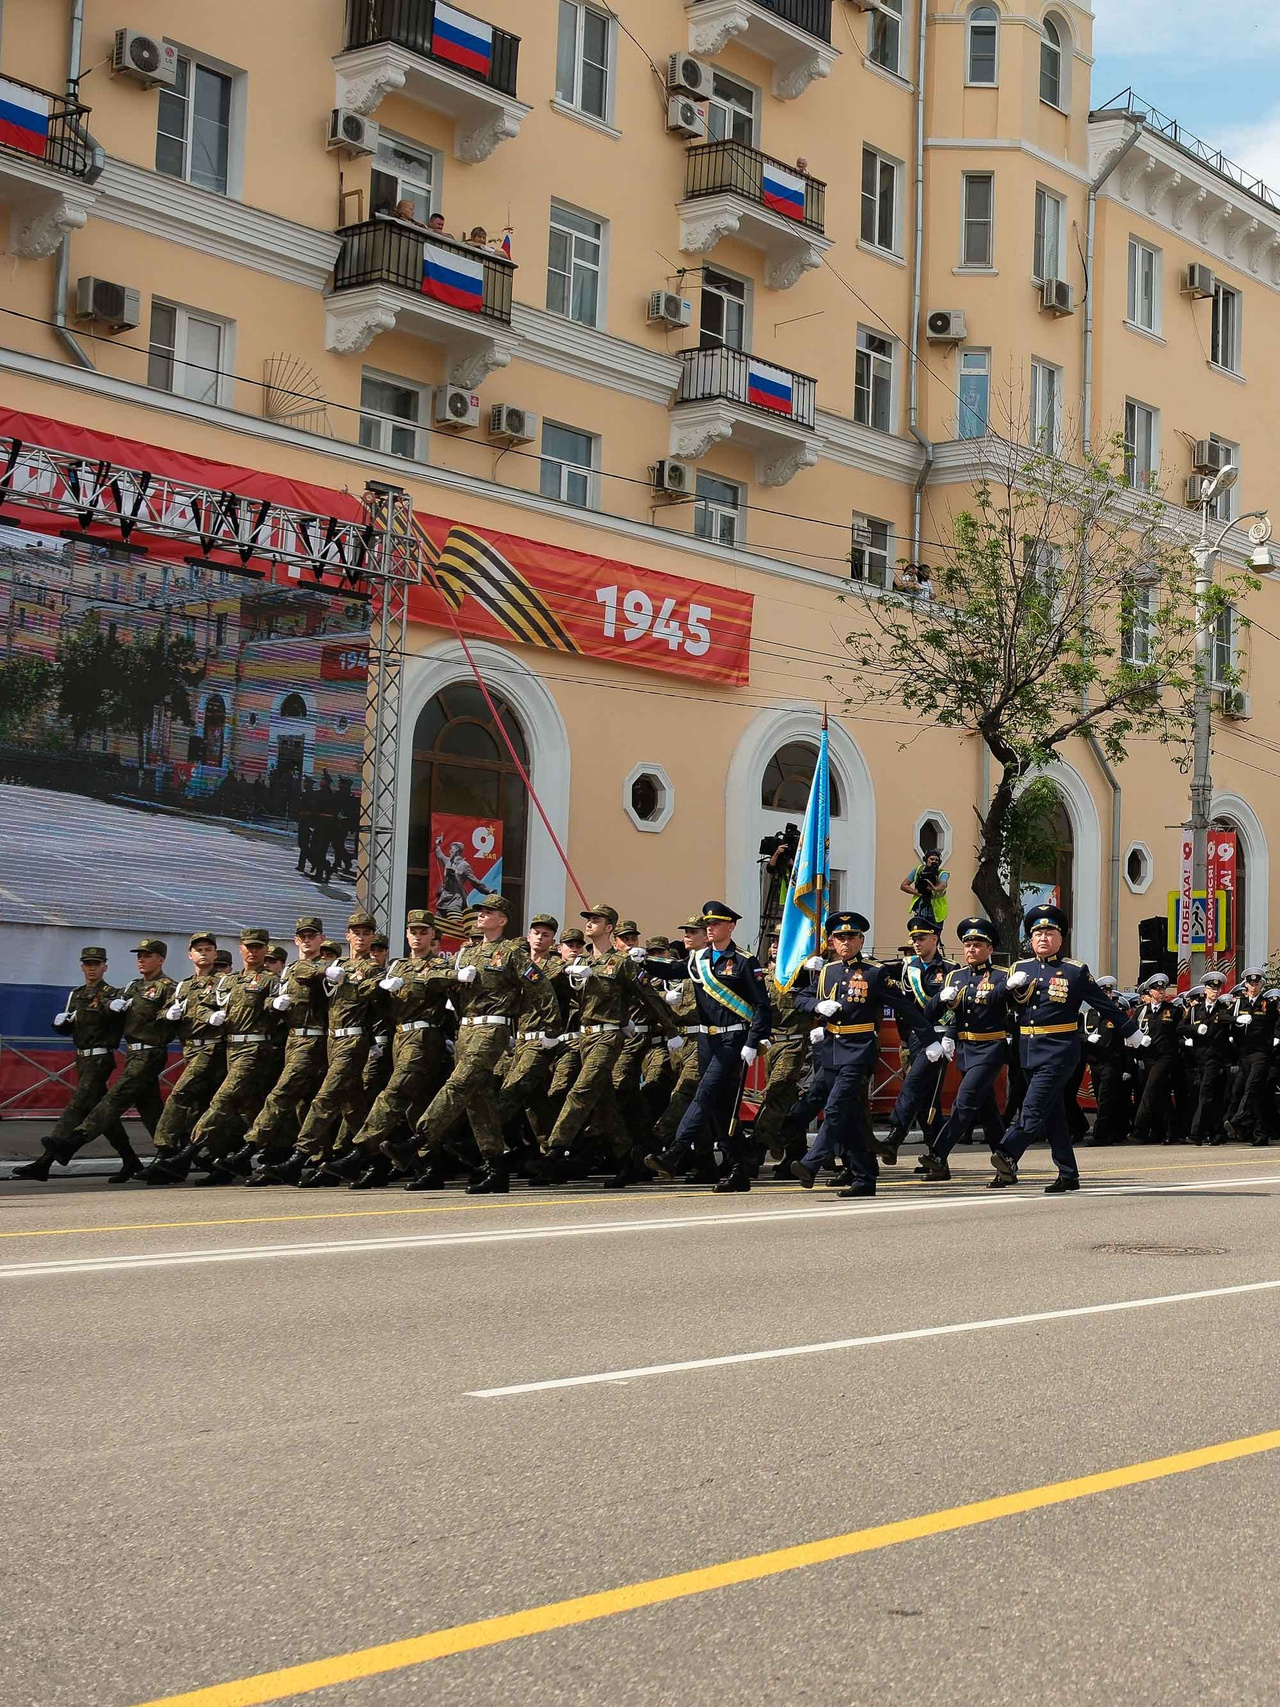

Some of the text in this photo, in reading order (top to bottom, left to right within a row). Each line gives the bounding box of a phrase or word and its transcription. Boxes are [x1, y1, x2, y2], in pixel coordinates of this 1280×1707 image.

[595, 584, 712, 656] 1945
[472, 826, 495, 859] 9
[1183, 842, 1193, 861] 9
[1208, 841, 1216, 860] 9
[1217, 843, 1234, 862] 9
[1182, 869, 1192, 944] ПОБЕДА!
